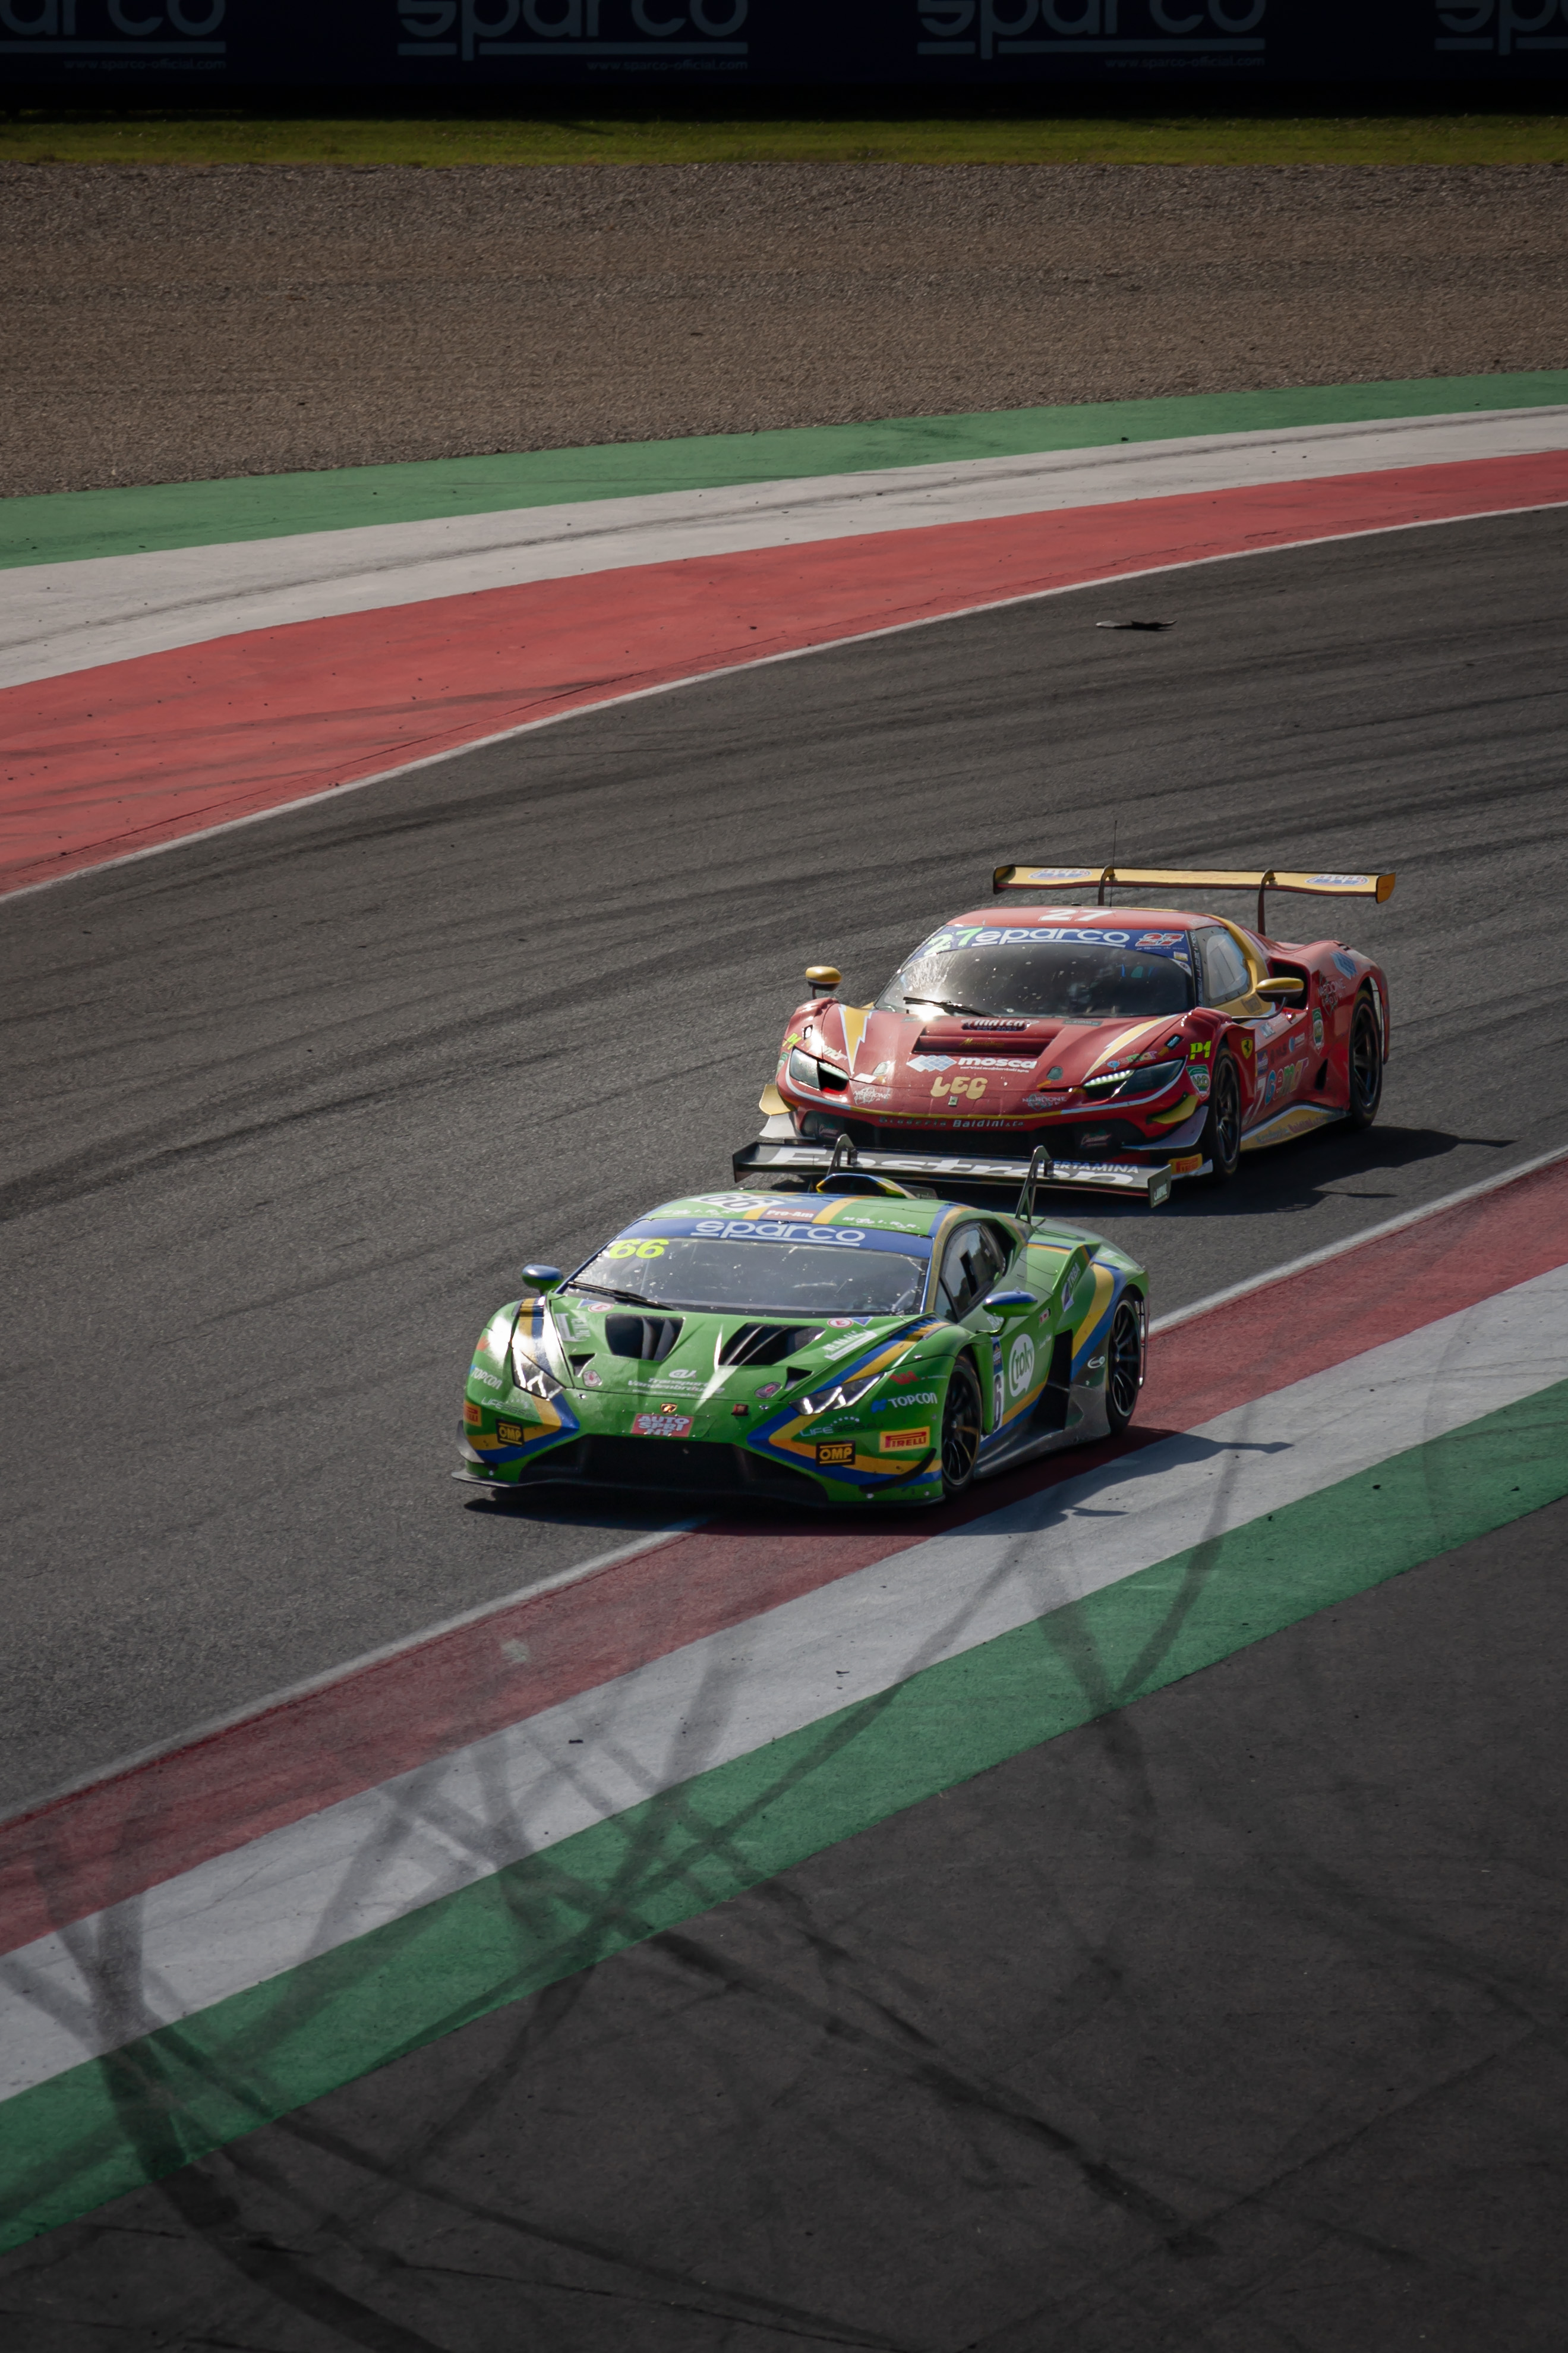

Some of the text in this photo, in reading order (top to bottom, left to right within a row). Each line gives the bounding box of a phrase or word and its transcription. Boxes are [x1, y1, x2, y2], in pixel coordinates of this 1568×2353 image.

[64, 58, 226, 70] www.sparco-official.com
[586, 59, 748, 71] www.sparco-official.com
[1105, 55, 1266, 68] www.sparco-official.com
[1039, 909, 1116, 922] 27
[923, 928, 983, 956] 27
[975, 928, 1130, 944] sparco
[1135, 933, 1185, 947] 27
[1190, 1041, 1212, 1060] P1
[958, 1057, 1037, 1069] mosca
[953, 1119, 1004, 1127] Baldini
[699, 1194, 773, 1209] 66
[766, 1209, 814, 1218] Pro-Am
[695, 1221, 866, 1242] sparco
[609, 1238, 669, 1259] 66
[471, 1368, 503, 1390] TOPCON
[888, 1393, 938, 1408] TOPCON
[638, 1415, 690, 1425] AUTO
[499, 1426, 522, 1441] OMP
[884, 1431, 927, 1448] PIRELLI
[819, 1447, 853, 1460] OMP
